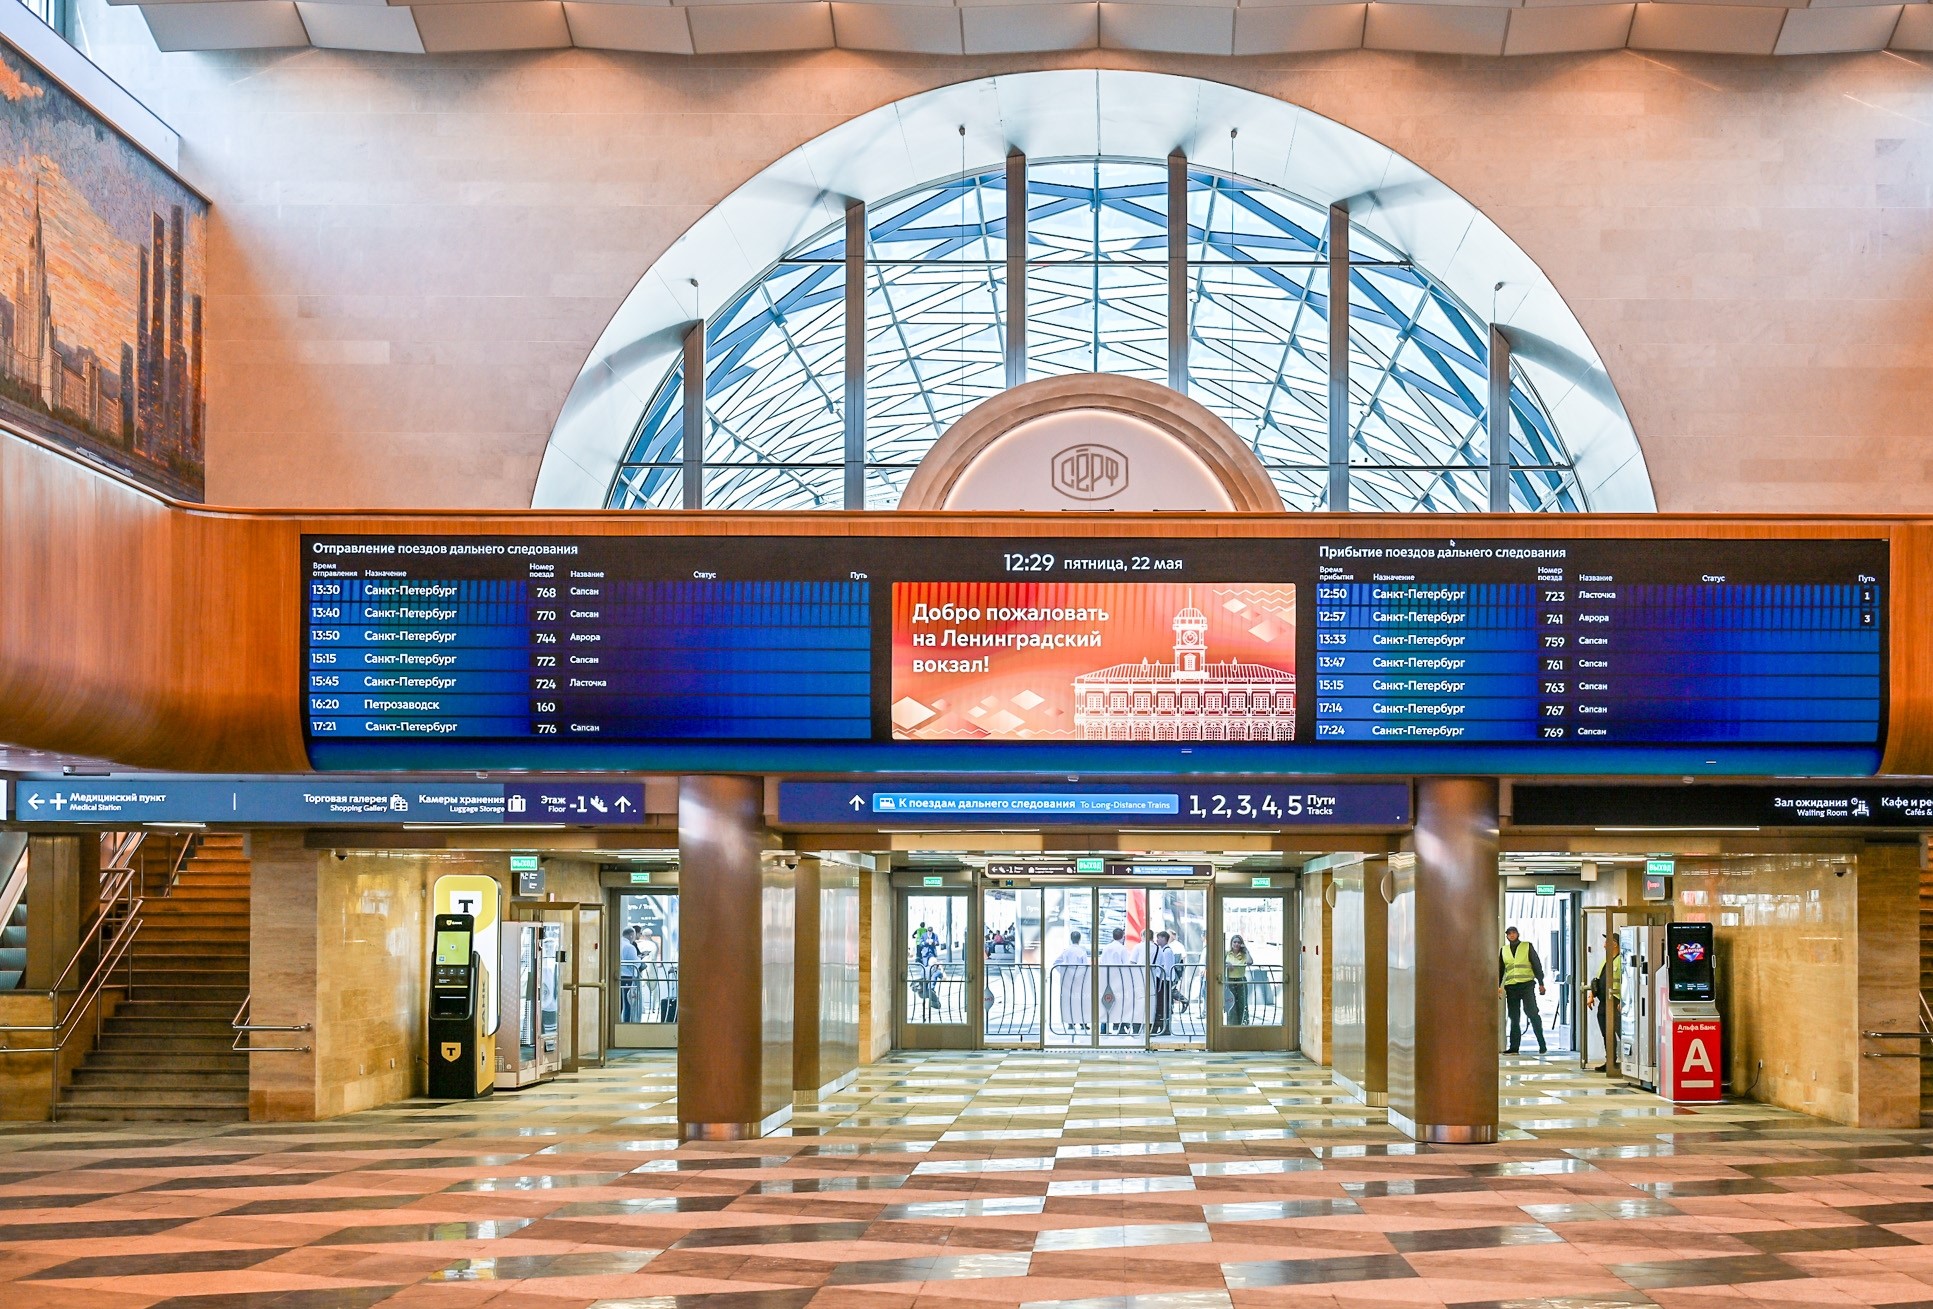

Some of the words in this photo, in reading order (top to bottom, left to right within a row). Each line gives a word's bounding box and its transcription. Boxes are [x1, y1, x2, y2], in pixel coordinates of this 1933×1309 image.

[313, 543, 395, 555] Отправление
[398, 545, 447, 555] поездов
[449, 545, 504, 555] дальнего
[507, 545, 578, 555] следования
[1319, 546, 1383, 558] Прибытие
[1385, 549, 1435, 558] поездов
[1437, 549, 1493, 559] дальнего
[1495, 549, 1566, 559] следования
[1004, 554, 1054, 571] 12:29
[1064, 558, 1128, 571] пятница,
[1132, 557, 1150, 570] 22
[1154, 558, 1183, 570] мая
[694, 571, 716, 579] Статус
[851, 572, 867, 580] Путь
[1702, 575, 1725, 583] Статус
[1859, 575, 1875, 583] Путь
[312, 585, 340, 595] 13:30
[365, 585, 457, 597] Санкт-Петербург
[537, 588, 556, 598] 768
[1319, 589, 1347, 599] 12:50
[1373, 589, 1465, 600] Санкт-Петербург
[1545, 592, 1564, 602] 723
[312, 608, 340, 618] 13:40
[365, 608, 457, 619] Санкт-Петербург
[537, 611, 556, 620] 770
[912, 605, 980, 623] Добро
[986, 607, 1109, 622] пожаловать
[1319, 612, 1345, 621] 12:57
[1373, 612, 1465, 623] Санкт-Петербург
[1547, 615, 1563, 624] 741
[1579, 614, 1609, 622] Аврора
[1864, 614, 1870, 622] 3
[312, 631, 340, 640] 13:50
[365, 631, 456, 642] Санкт-Петербург
[537, 634, 556, 643] 744
[570, 633, 600, 641] Аврора
[913, 633, 936, 647] на
[941, 630, 1101, 650] Ленинградский
[1319, 635, 1346, 644] 13:33
[1373, 635, 1465, 646] Санкт-Петербург
[1545, 637, 1564, 647] 759
[312, 654, 336, 663] 15:15
[365, 654, 456, 665] Санкт-Петербург
[536, 657, 555, 666] 772
[912, 656, 989, 673] вокзал!
[1319, 658, 1345, 667] 13:47
[1373, 658, 1465, 669] Санкт-Петербург
[1547, 660, 1563, 670] 761
[312, 677, 339, 686] 15:45
[364, 677, 456, 688] Санкт-Петербург
[536, 680, 556, 689] 724
[570, 679, 606, 687] Ласточка
[1319, 681, 1344, 690] 15:15
[1373, 681, 1465, 692] Санкт-Петербург
[1545, 683, 1564, 693] 763
[312, 700, 339, 709] 16:20
[365, 700, 439, 711] Петрозаводск
[537, 703, 555, 712] 160
[1319, 703, 1342, 713] 17:14
[1373, 704, 1465, 715] Санкт-Петербург
[1546, 706, 1564, 716] 767
[313, 722, 336, 731] 17:21
[366, 722, 457, 733] Санкт-Петербург
[538, 725, 556, 734] 776
[1319, 726, 1345, 735] 17:24
[1372, 726, 1464, 737] Санкт-Петербург
[1544, 728, 1563, 738] 769
[70, 793, 136, 803] Медицинский
[139, 795, 166, 803] пункт
[304, 795, 347, 804] Торговая
[349, 796, 387, 804] галерея
[419, 795, 457, 804] Камеры
[459, 796, 505, 804] хранения
[540, 796, 565, 805] Этаж
[570, 795, 587, 812] -1
[899, 798, 907, 807] К
[909, 800, 957, 808] поездам
[958, 800, 1008, 809] дальнего
[1011, 800, 1075, 809] следования
[1307, 796, 1335, 806] Пути
[1774, 798, 1793, 806] Зал
[1795, 798, 1848, 808] ожидания
[1882, 797, 1908, 808] Кафе
[330, 804, 362, 813] Shopping
[364, 804, 387, 813] Gallery
[1080, 801, 1090, 809] To
[1091, 801, 1145, 810] Long-Distance
[1149, 801, 1170, 809] Trains
[1189, 795, 1207, 818] 1,
[1212, 795, 1231, 818] 2,
[1237, 795, 1257, 818] 3,
[1262, 795, 1282, 818] 4,
[1288, 795, 1302, 814] 5
[1307, 807, 1332, 815] Tracks
[1797, 809, 1825, 817] Waiting
[1079, 860, 1101, 871] ВЫХОД
[1649, 863, 1672, 873] ВЫХОД
[1682, 1038, 1713, 1072] А
